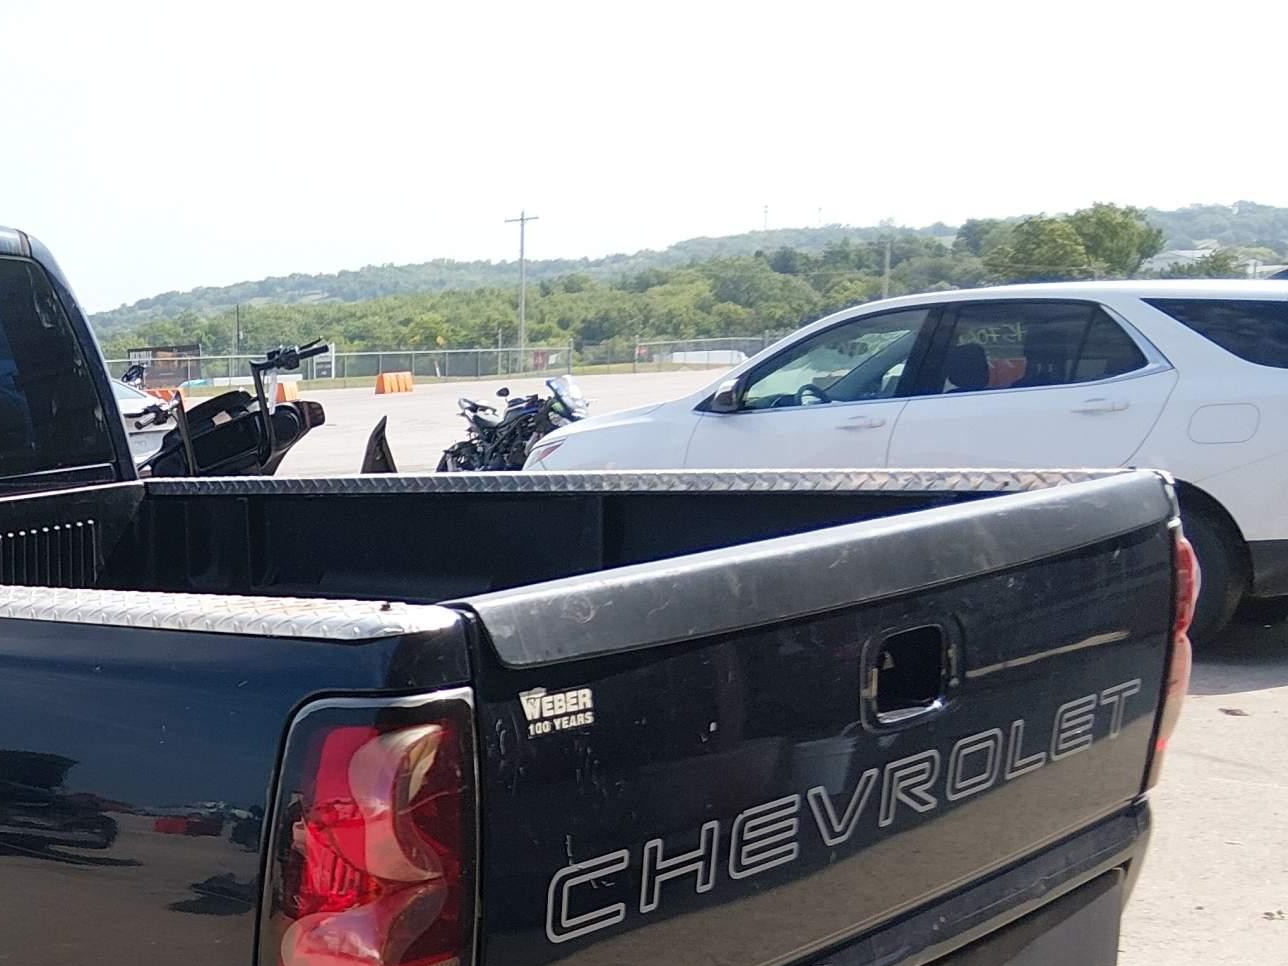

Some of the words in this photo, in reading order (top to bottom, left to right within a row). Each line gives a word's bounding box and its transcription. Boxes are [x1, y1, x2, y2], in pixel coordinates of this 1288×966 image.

[519, 687, 594, 721] WEBER
[528, 721, 552, 735] 100
[553, 711, 595, 731] YEARS
[546, 678, 1142, 943] CHEVROLET
